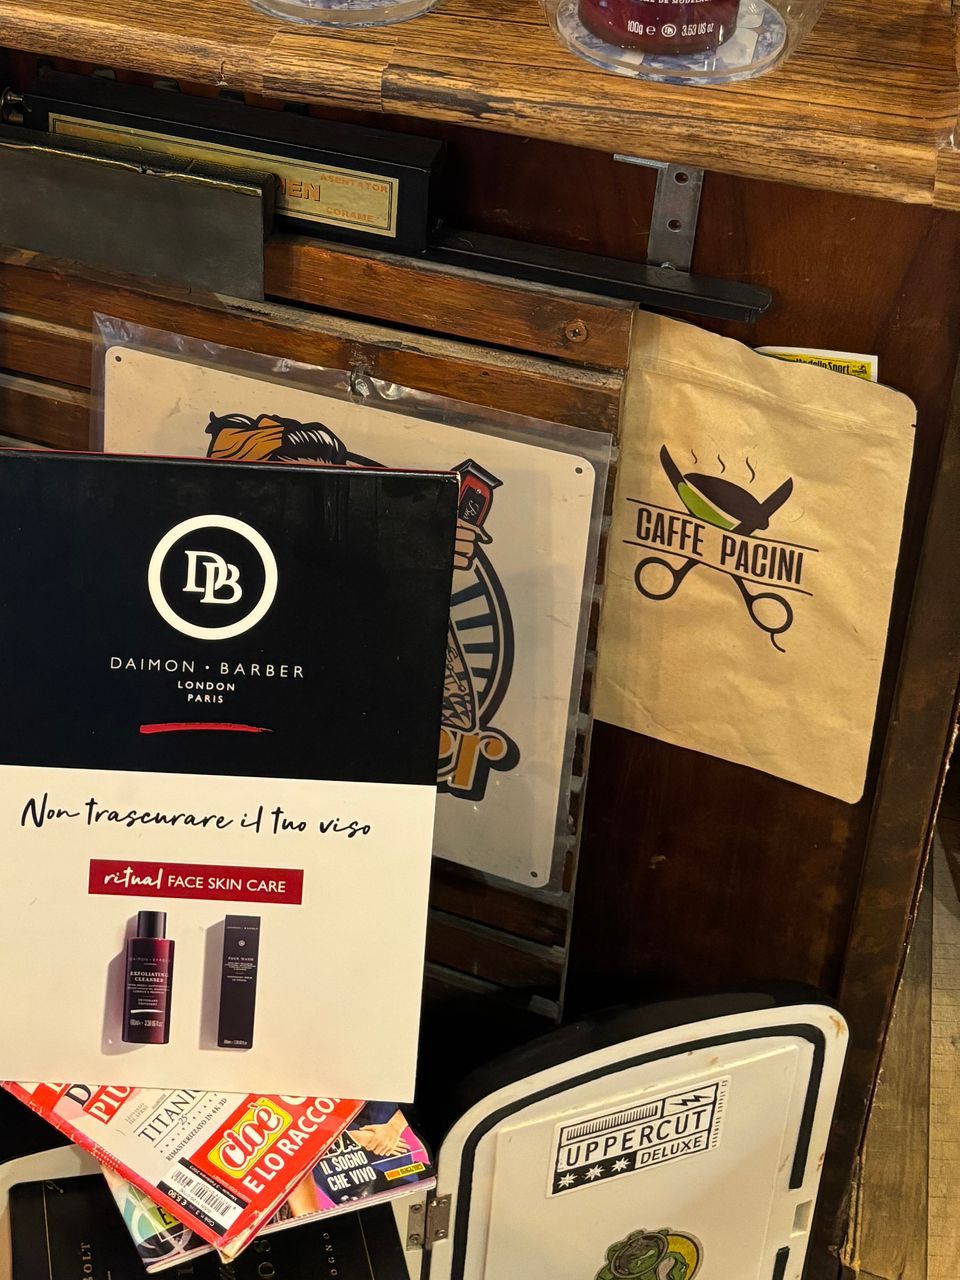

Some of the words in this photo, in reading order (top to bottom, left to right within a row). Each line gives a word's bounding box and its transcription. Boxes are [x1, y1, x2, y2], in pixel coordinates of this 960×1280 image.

[627, 19, 644, 36] 100g
[681, 24, 697, 37] 3.53
[697, 23, 708, 35] US
[326, 206, 375, 223] CORAME
[636, 506, 705, 557] CAFFE
[719, 537, 803, 585] PACINI
[110, 656, 195, 674] DAIMON
[220, 663, 305, 679] BARBER
[177, 681, 235, 692] LONDON
[187, 693, 224, 704] PARIS
[20, 792, 81, 829] Non
[83, 797, 235, 832] trascurare
[239, 805, 264, 836] il
[271, 805, 308, 836] tuo
[317, 816, 373, 840] viso
[103, 868, 164, 890] ritual
[167, 875, 205, 890] FACE
[208, 877, 243, 891] SKIN
[246, 879, 287, 894] CARE
[165, 1120, 208, 1162] RIMASTERIZZATO
[205, 1112, 215, 1123] IN
[211, 1103, 221, 1115] 4K
[218, 1097, 228, 1108] 3D
[566, 1109, 707, 1167] UPPERCUT
[320, 1160, 334, 1176] IL
[333, 1150, 369, 1172] SOGNO
[640, 1135, 702, 1165] DELUXE
[253, 1153, 286, 1183] LO
[327, 1175, 351, 1192] CHE
[350, 1165, 377, 1186] VIVO
[242, 1174, 266, 1195] E
[180, 1198, 188, 1207] €
